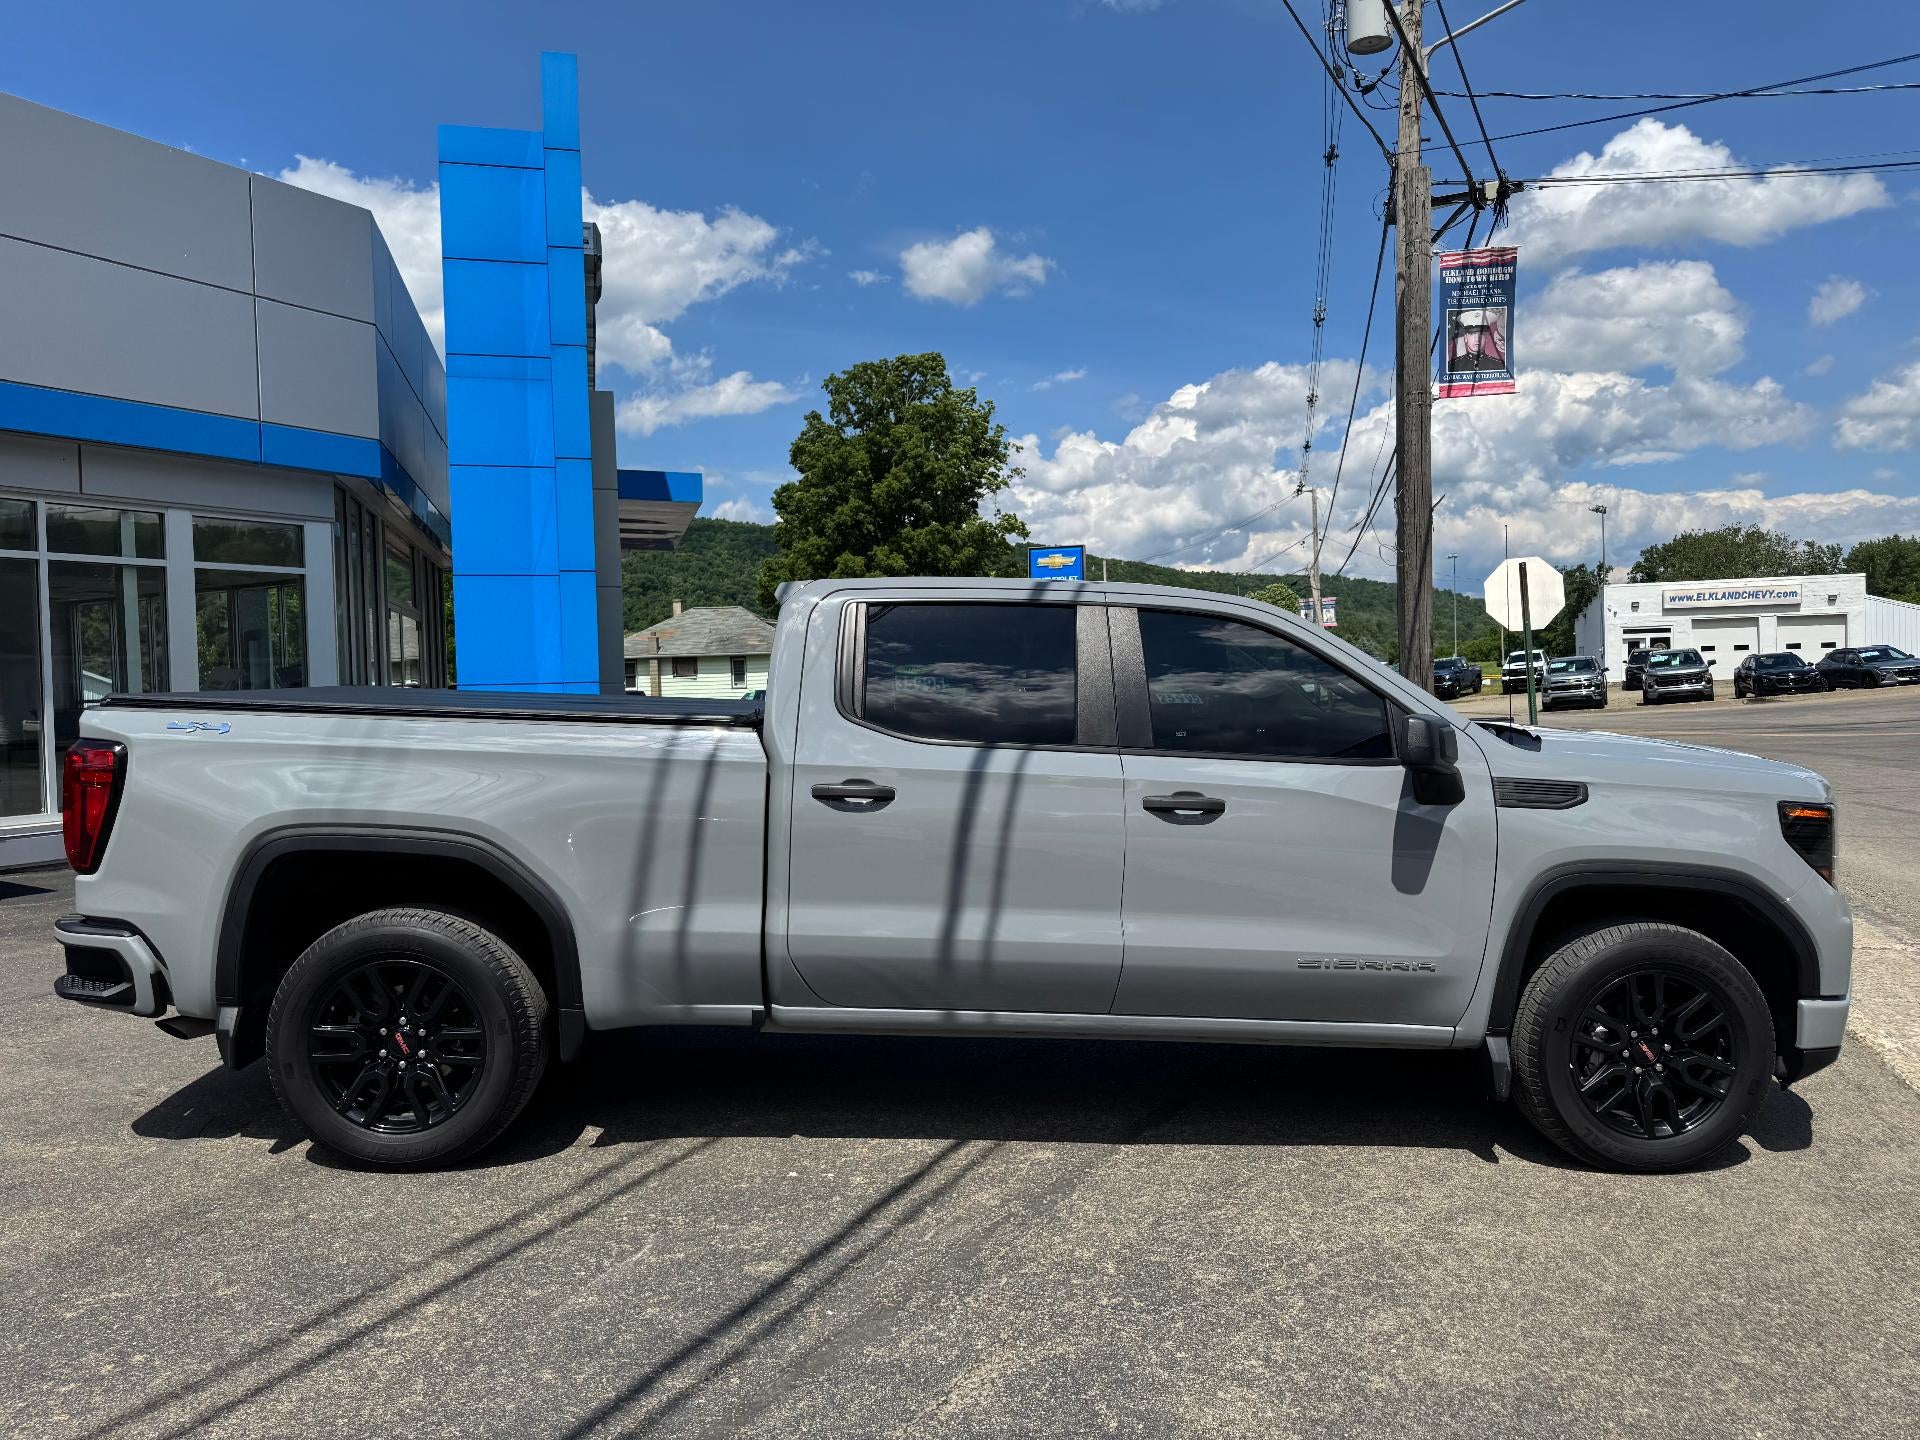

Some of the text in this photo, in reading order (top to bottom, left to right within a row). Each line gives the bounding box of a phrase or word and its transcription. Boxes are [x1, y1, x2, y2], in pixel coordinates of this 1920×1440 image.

[1442, 266, 1514, 277] ELKLAND BOROUGH
[1445, 274, 1510, 284] HOMETOWN HERO
[1669, 589, 1798, 603] www.ELKLANDCHEVY.com
[1297, 958, 1437, 972] SIERRA
